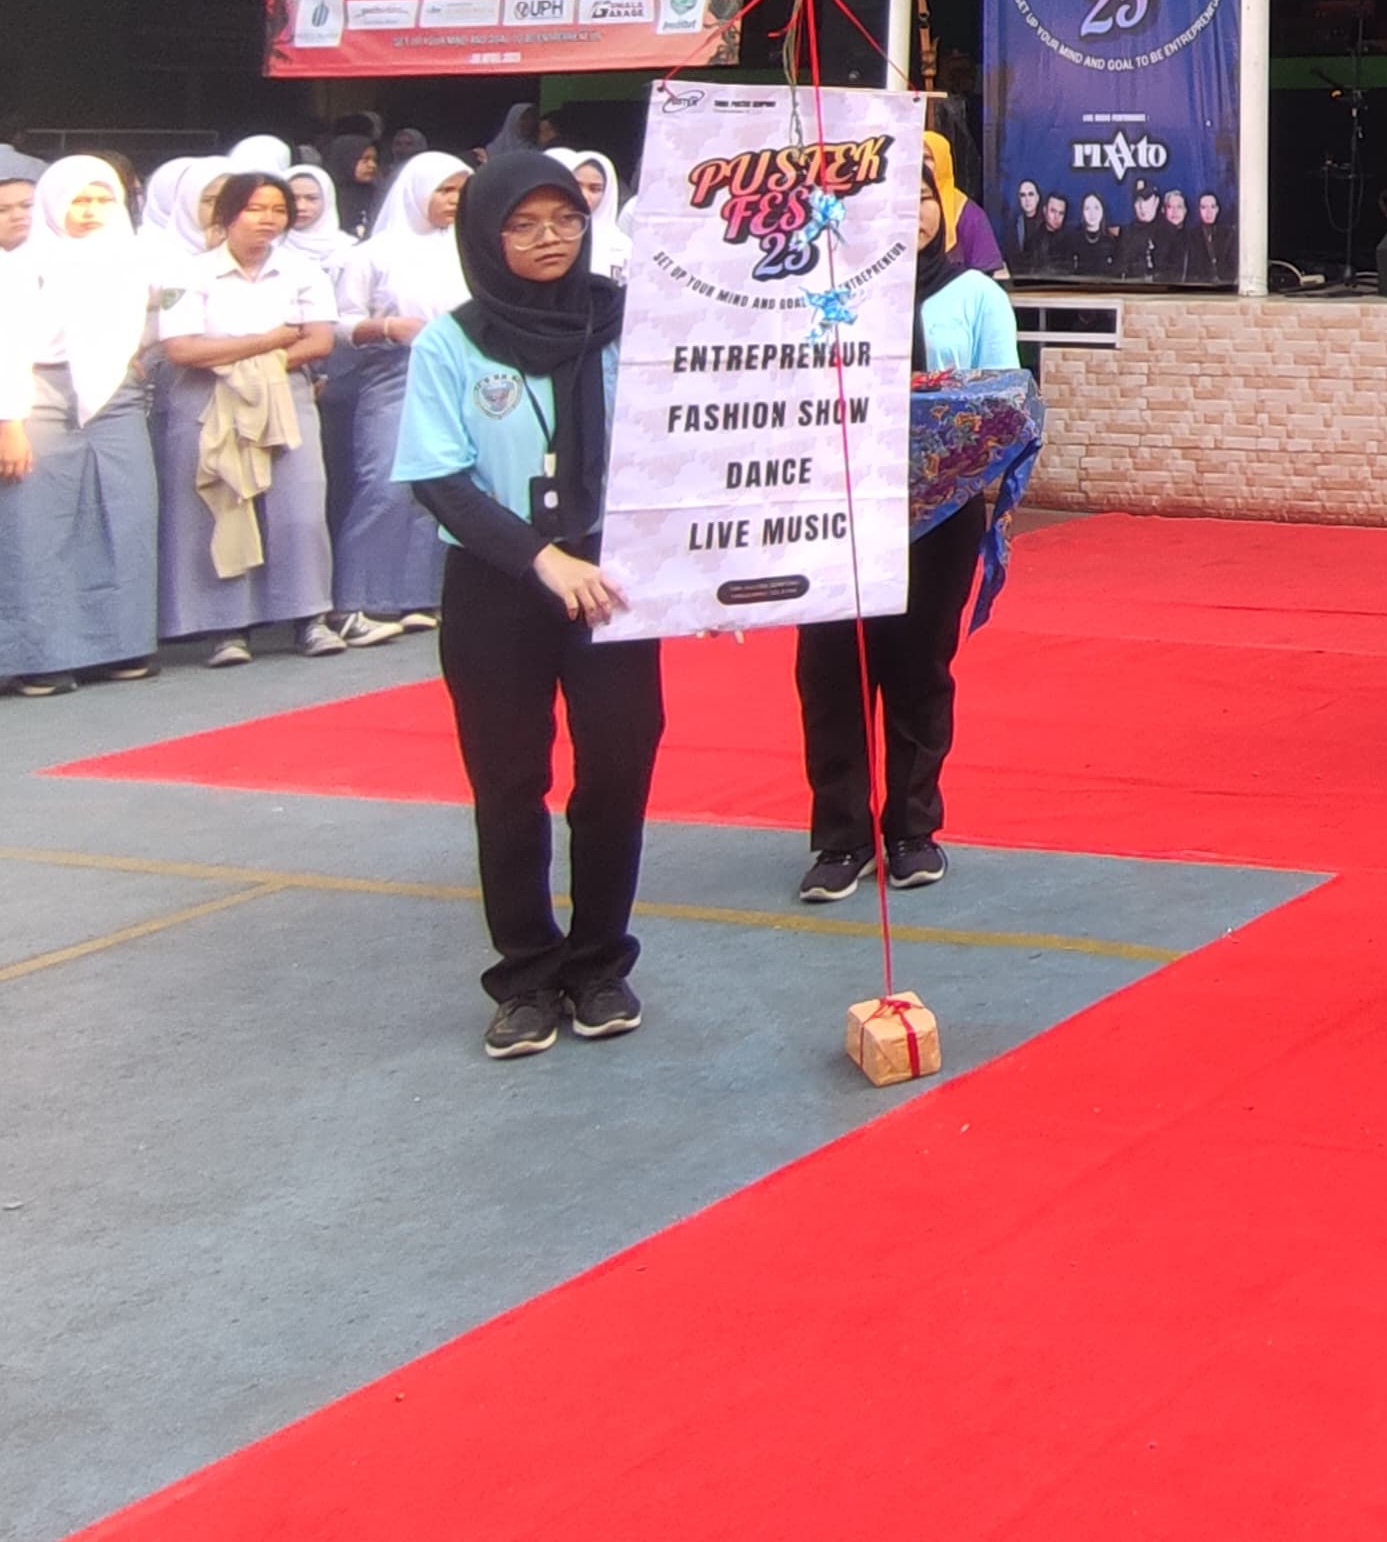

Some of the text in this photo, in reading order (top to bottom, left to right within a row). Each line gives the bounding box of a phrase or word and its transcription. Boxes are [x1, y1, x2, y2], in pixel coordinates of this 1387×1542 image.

[531, 0, 564, 16] UPH
[1025, 11, 1038, 30] UP
[1036, 24, 1059, 50] YOUR
[1058, 43, 1084, 64] MIND
[1083, 56, 1105, 70] AND
[1107, 57, 1134, 71] GOAL
[1135, 55, 1149, 69] TO
[1150, 48, 1164, 64] BE
[689, 135, 892, 207] PUSTEK
[720, 181, 820, 244] FES
[753, 231, 819, 281] 25
[652, 250, 671, 270] SET
[670, 263, 688, 281] UP
[685, 271, 715, 298] YOUR
[716, 289, 748, 308] MIND
[751, 296, 776, 309] AND
[673, 341, 872, 373] ENTREPRENEUR
[667, 396, 870, 434] FASHION SHOW
[725, 457, 814, 490] DANCE
[688, 512, 848, 551] LIVE MUSIC
